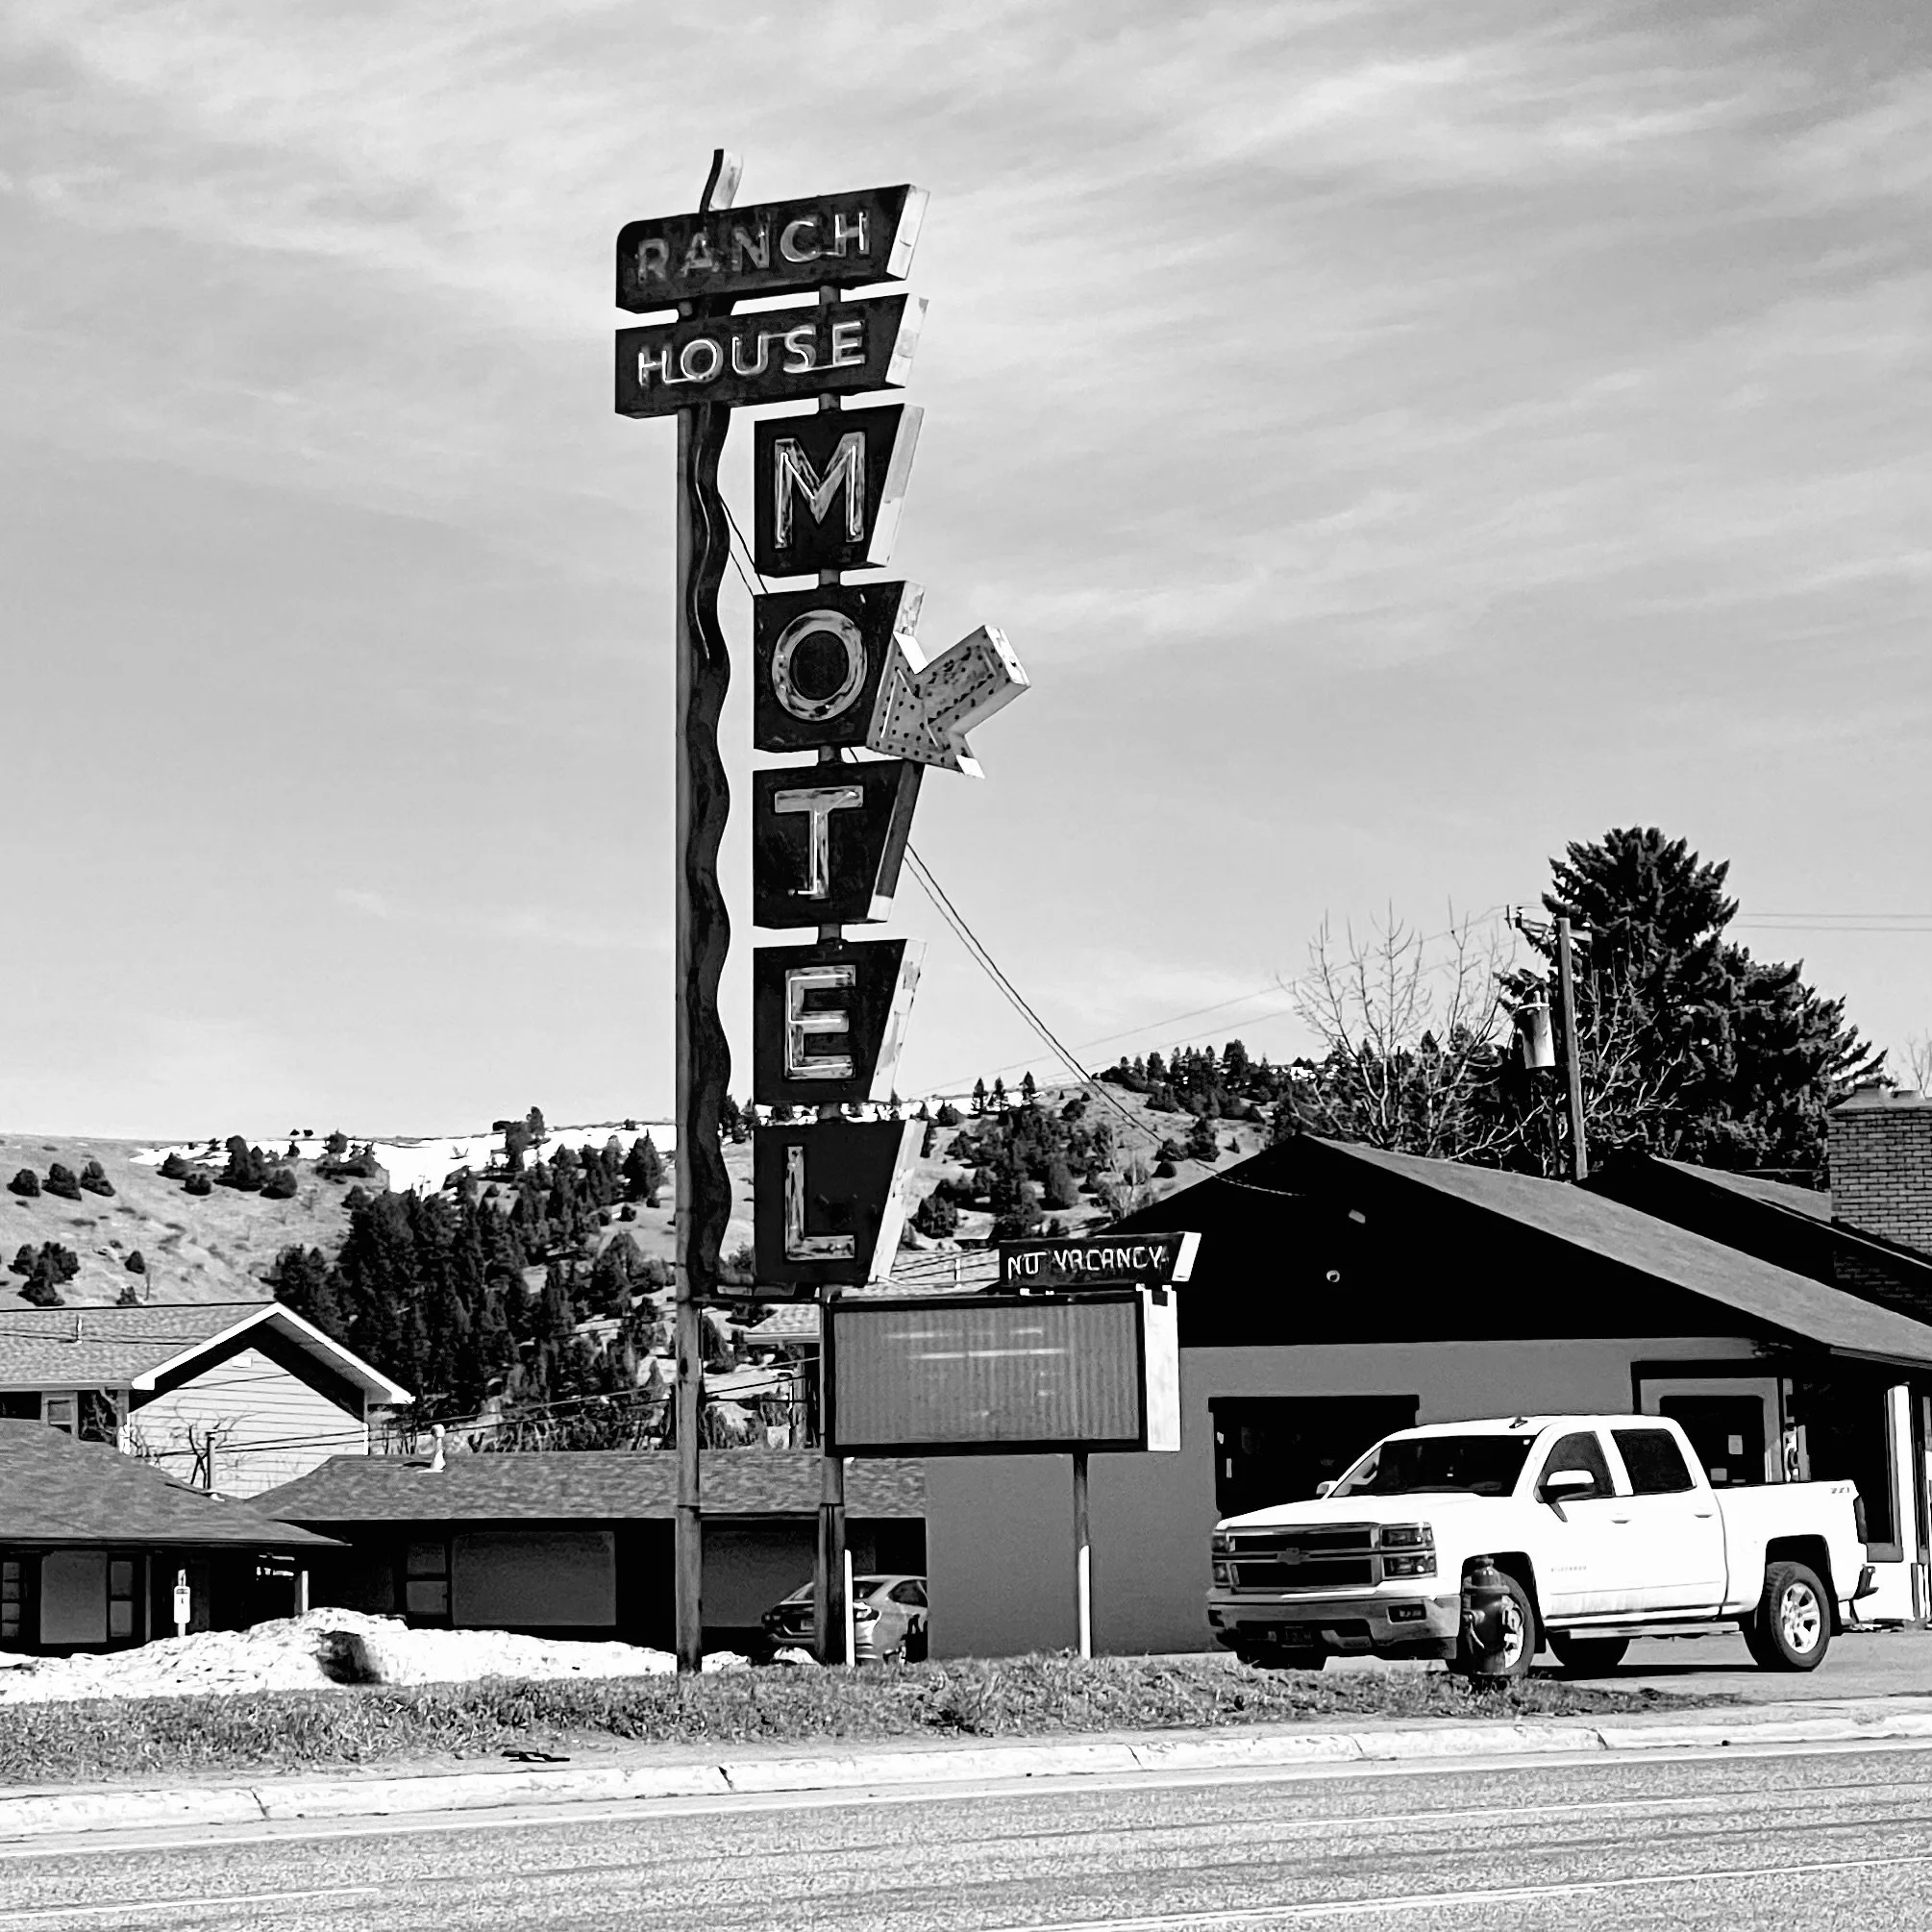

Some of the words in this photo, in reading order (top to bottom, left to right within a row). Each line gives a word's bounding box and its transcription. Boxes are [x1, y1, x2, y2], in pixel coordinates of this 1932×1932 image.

[636, 211, 870, 285] RANCH
[637, 320, 866, 388] HOUSE
[772, 432, 867, 1261] MOTEL
[1008, 1251, 1045, 1279] NO
[1053, 1246, 1167, 1272] VACANCY
